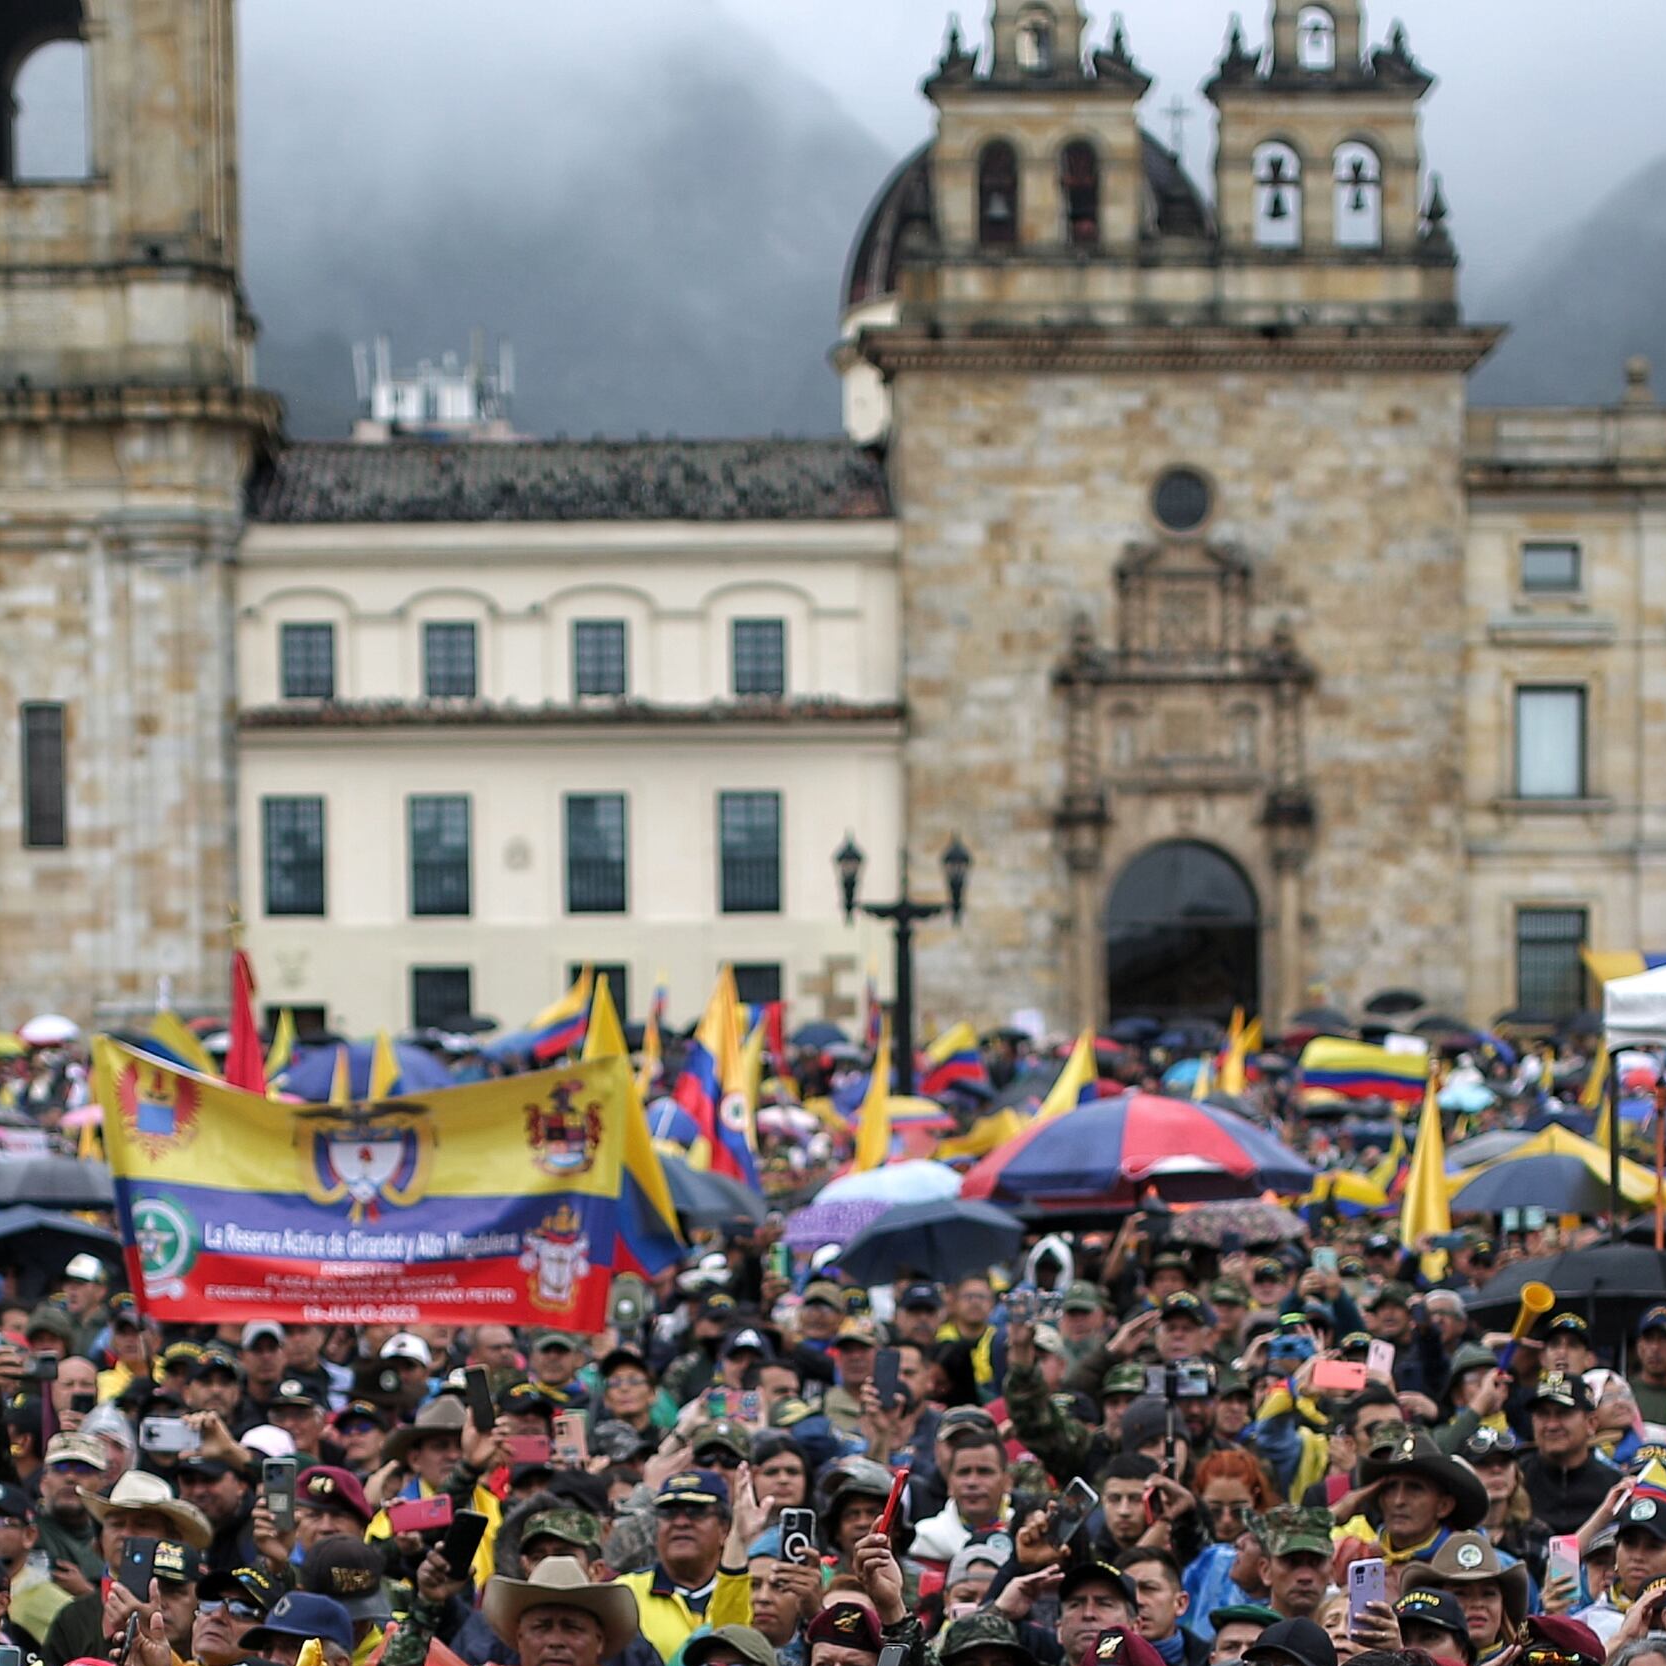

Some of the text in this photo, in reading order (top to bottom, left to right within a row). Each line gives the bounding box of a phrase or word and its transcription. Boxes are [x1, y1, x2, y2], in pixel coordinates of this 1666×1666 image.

[203, 1218, 223, 1250] La
[223, 1221, 282, 1255] Reserva
[326, 1228, 346, 1259] de
[346, 1229, 406, 1261] Girardot
[414, 1231, 446, 1261] Alto
